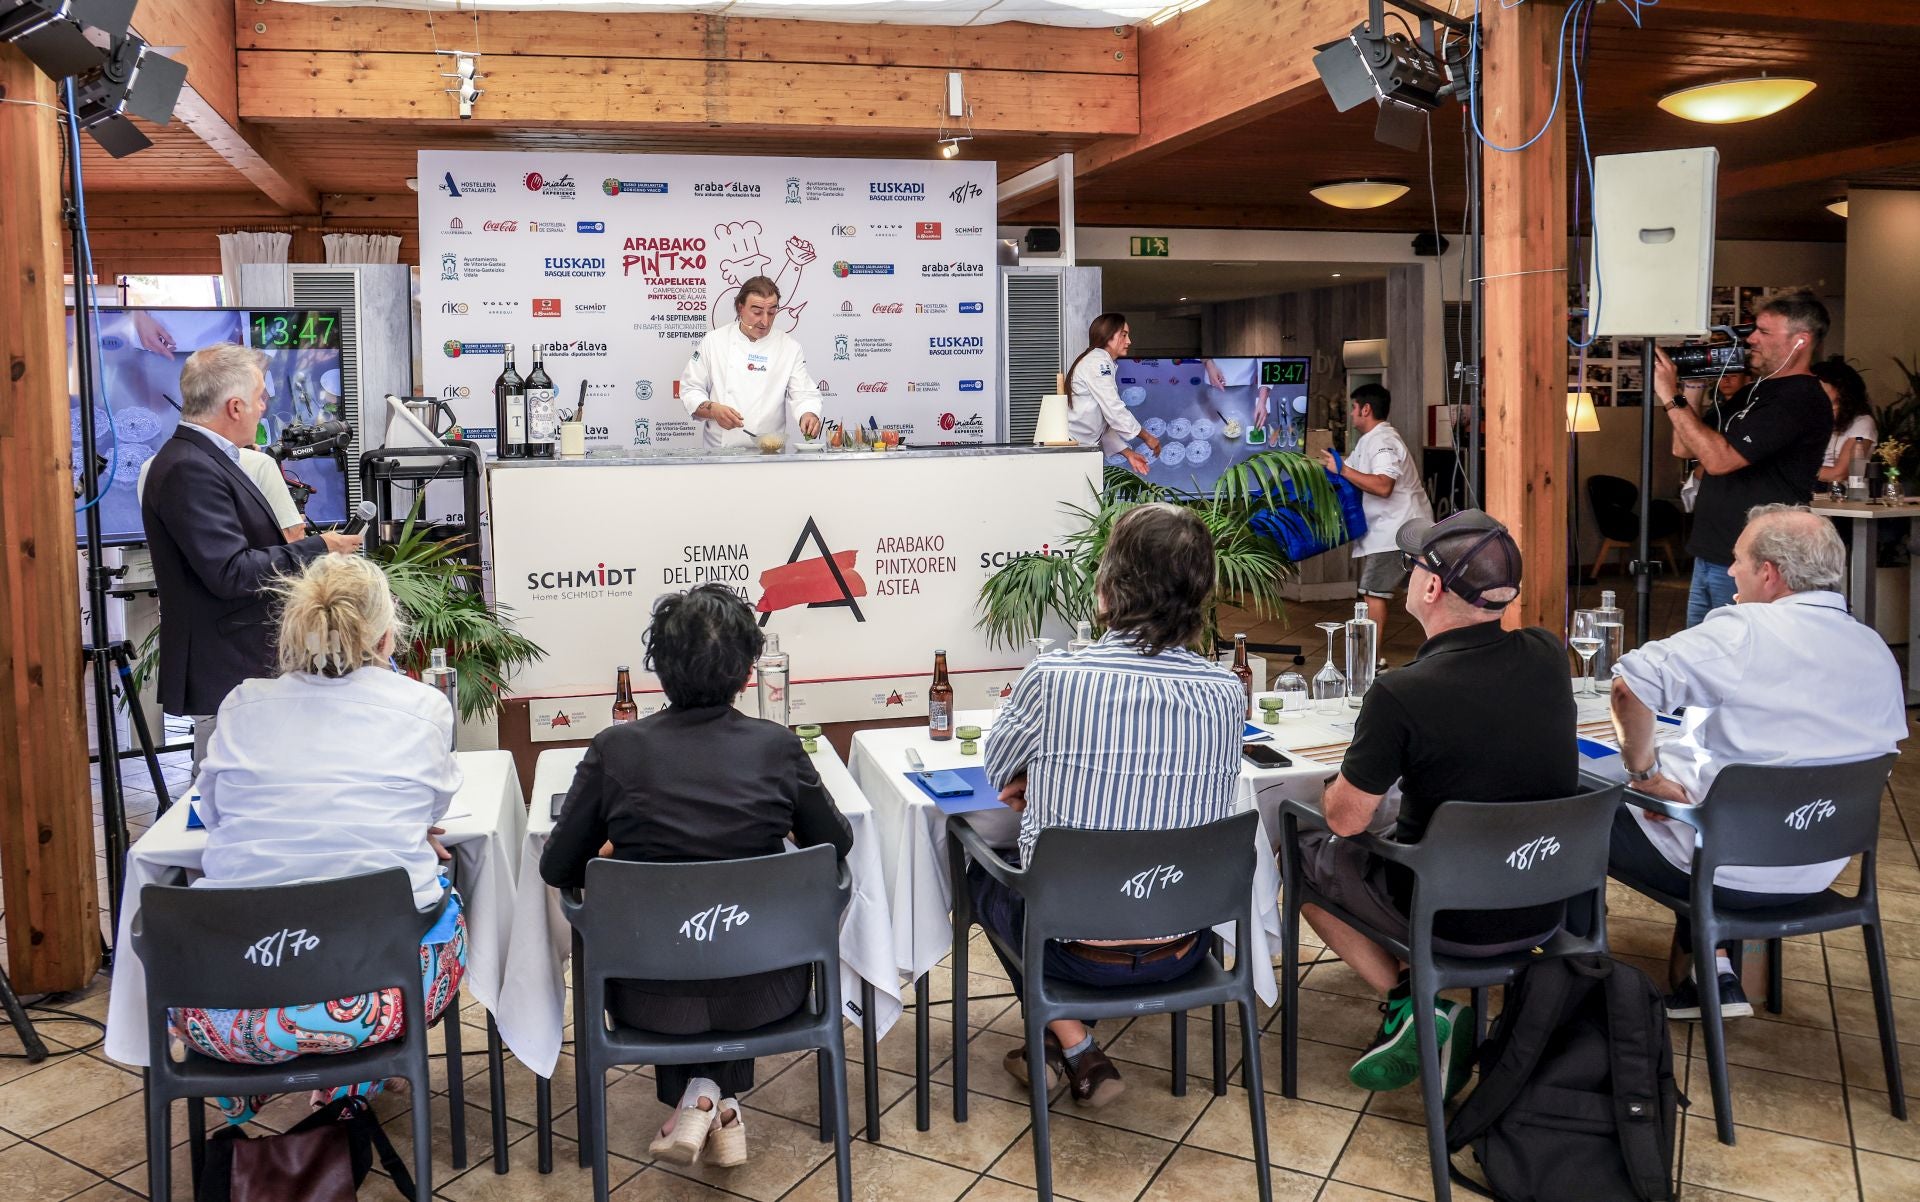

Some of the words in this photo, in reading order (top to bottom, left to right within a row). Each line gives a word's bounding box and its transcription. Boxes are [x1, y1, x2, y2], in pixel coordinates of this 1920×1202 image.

[694, 182, 723, 191] araba
[732, 182, 761, 192] álava
[870, 182, 924, 193] EUSKADI
[949, 181, 982, 203] 18/70
[623, 238, 706, 251] ARABAKO
[545, 258, 605, 268] EUSKADI
[623, 251, 706, 277] PINTXO
[922, 263, 949, 271] araba
[957, 262, 983, 271] álava
[677, 302, 706, 310] 2025
[255, 317, 335, 345] 13:47
[544, 341, 568, 350] raba
[578, 341, 607, 350] álava
[930, 337, 983, 347] EUSKADI
[1264, 365, 1303, 382] 13:47
[512, 416, 521, 427] T
[586, 425, 608, 434] lava
[819, 417, 838, 439] /70
[293, 447, 313, 455] RONIN
[446, 513, 463, 521] ara
[684, 544, 748, 562] SEMANA
[876, 536, 944, 553] ARABAKO
[664, 567, 691, 584] DEL
[696, 564, 749, 582] PINTXO
[876, 557, 956, 575] PINTXOREN
[876, 579, 920, 596] ASTEA
[1785, 799, 1836, 830] 18/70
[1506, 836, 1560, 870] 18/70
[1120, 865, 1183, 899] 18/70
[677, 904, 749, 944] 18/70
[245, 929, 320, 966] 18/70
